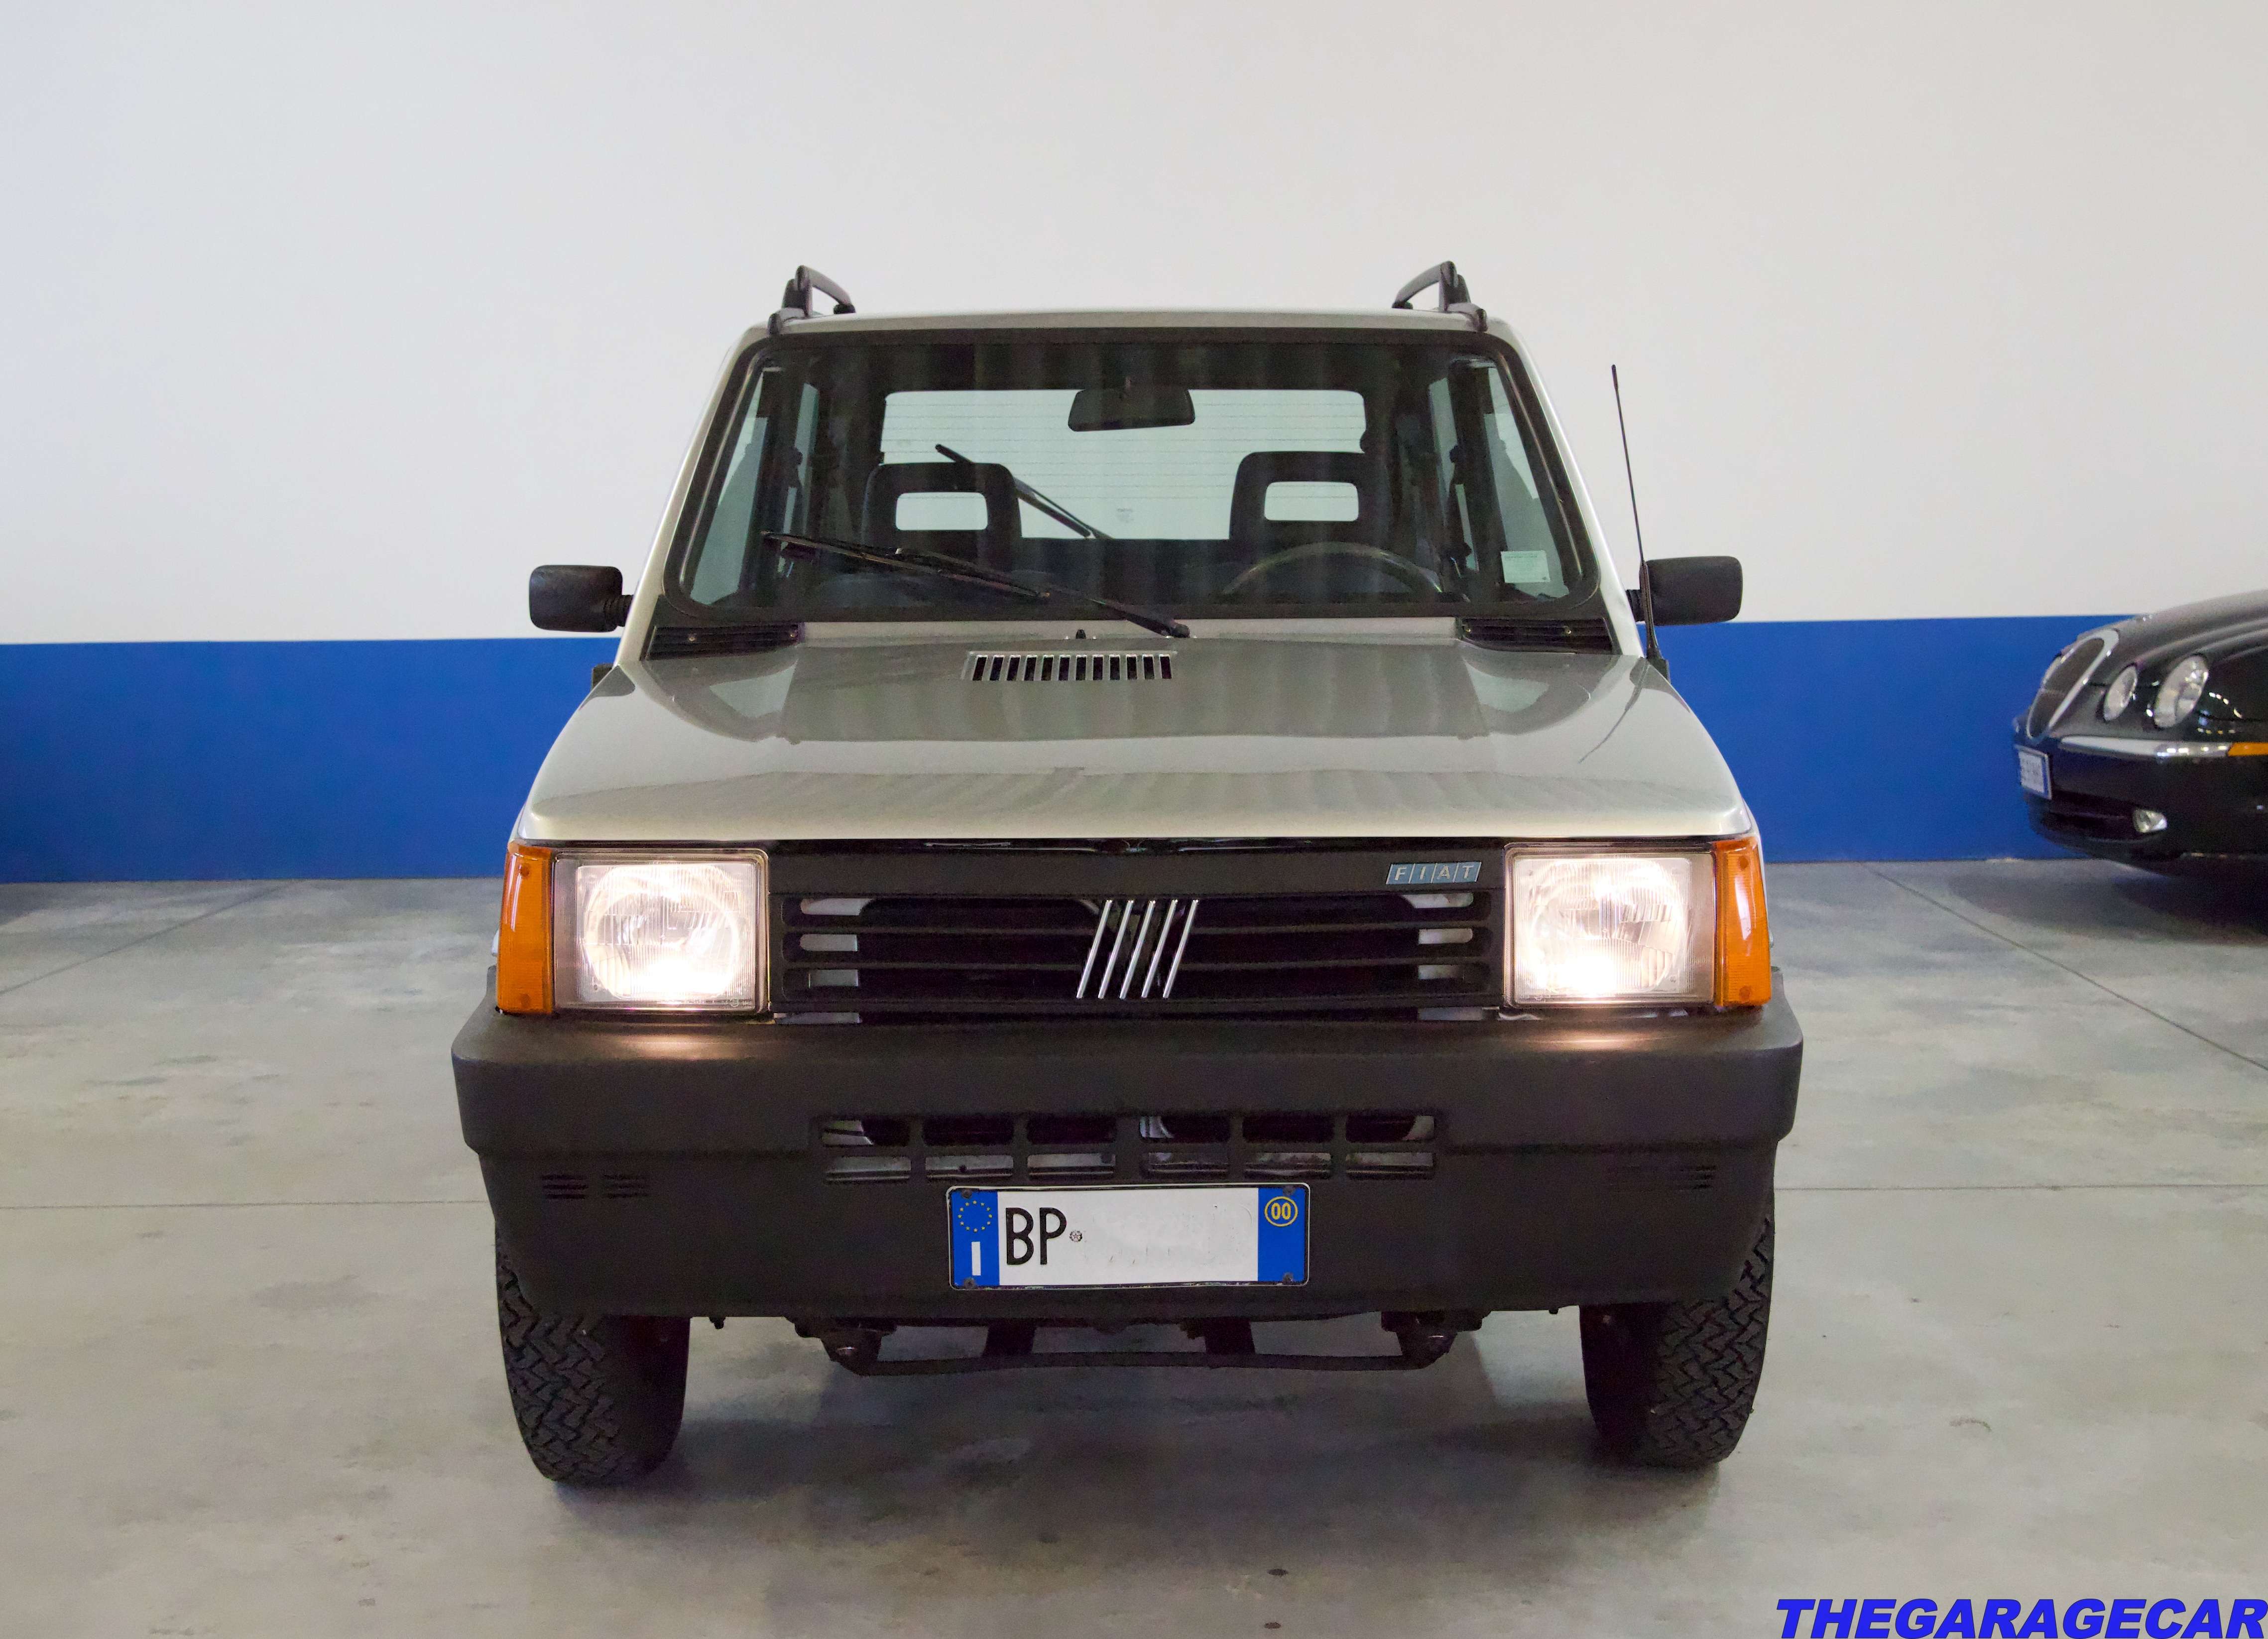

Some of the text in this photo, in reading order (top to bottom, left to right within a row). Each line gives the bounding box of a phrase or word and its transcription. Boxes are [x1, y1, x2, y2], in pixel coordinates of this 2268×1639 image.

[1395, 865, 1474, 881] FIAT
[1271, 1203, 1291, 1220] 00
[1006, 1207, 1067, 1265] BP
[971, 1242, 981, 1276] I
